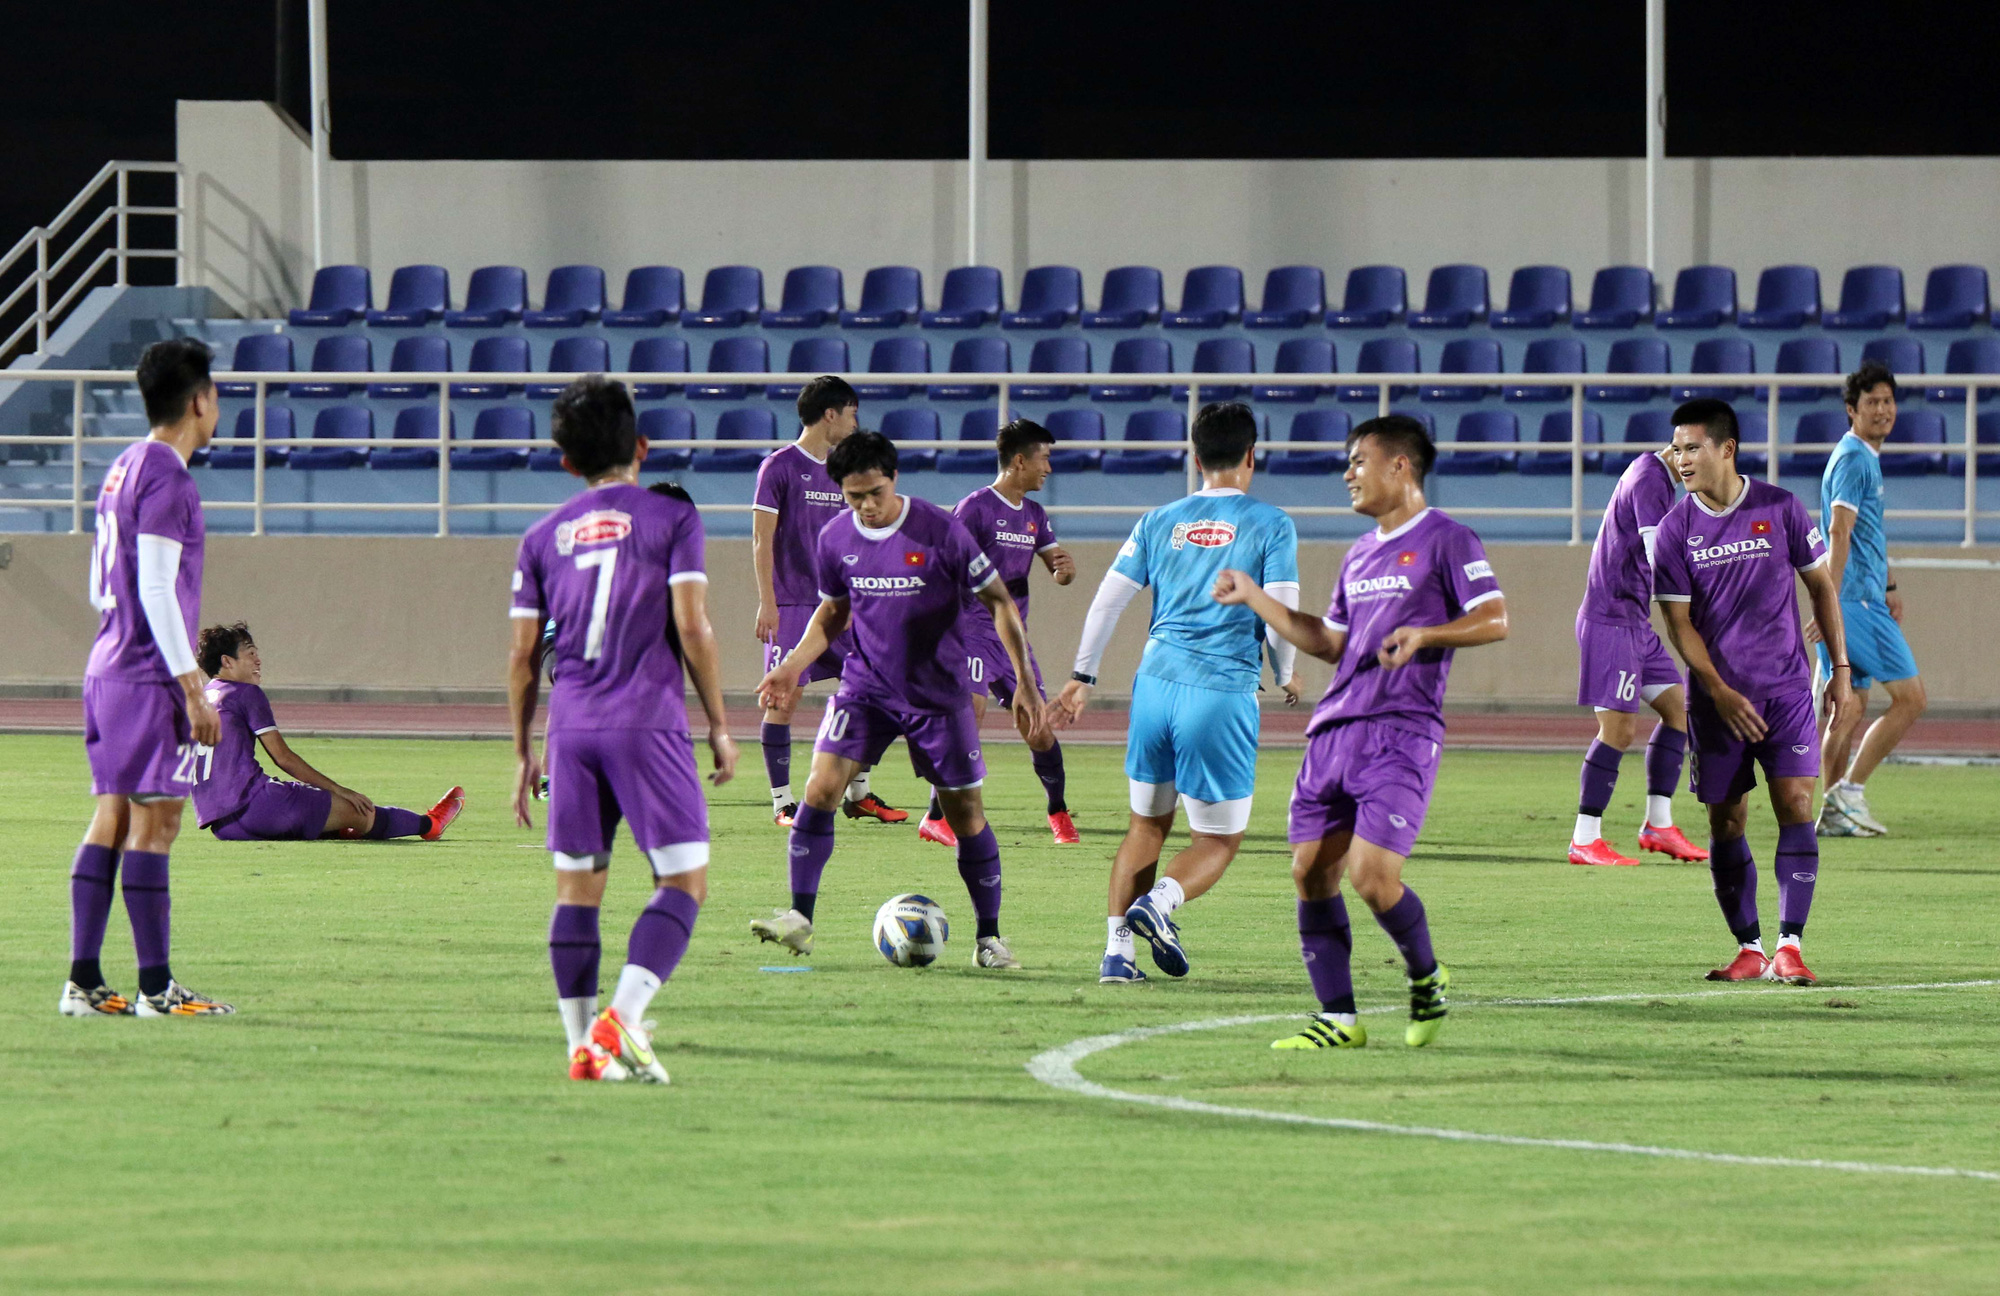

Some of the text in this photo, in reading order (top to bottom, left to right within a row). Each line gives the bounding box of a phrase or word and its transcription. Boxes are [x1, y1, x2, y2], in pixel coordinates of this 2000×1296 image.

[995, 531, 1036, 545] HONDA
[1691, 538, 1772, 562] HONDA
[1710, 557, 1733, 567] Power
[1733, 554, 1741, 562] of
[1743, 552, 1770, 560] Dreams
[850, 576, 926, 589] HONDA
[1345, 575, 1413, 597] HONDA
[575, 547, 618, 660] 7
[1616, 670, 1637, 702] 16
[897, 906, 928, 916] molten
